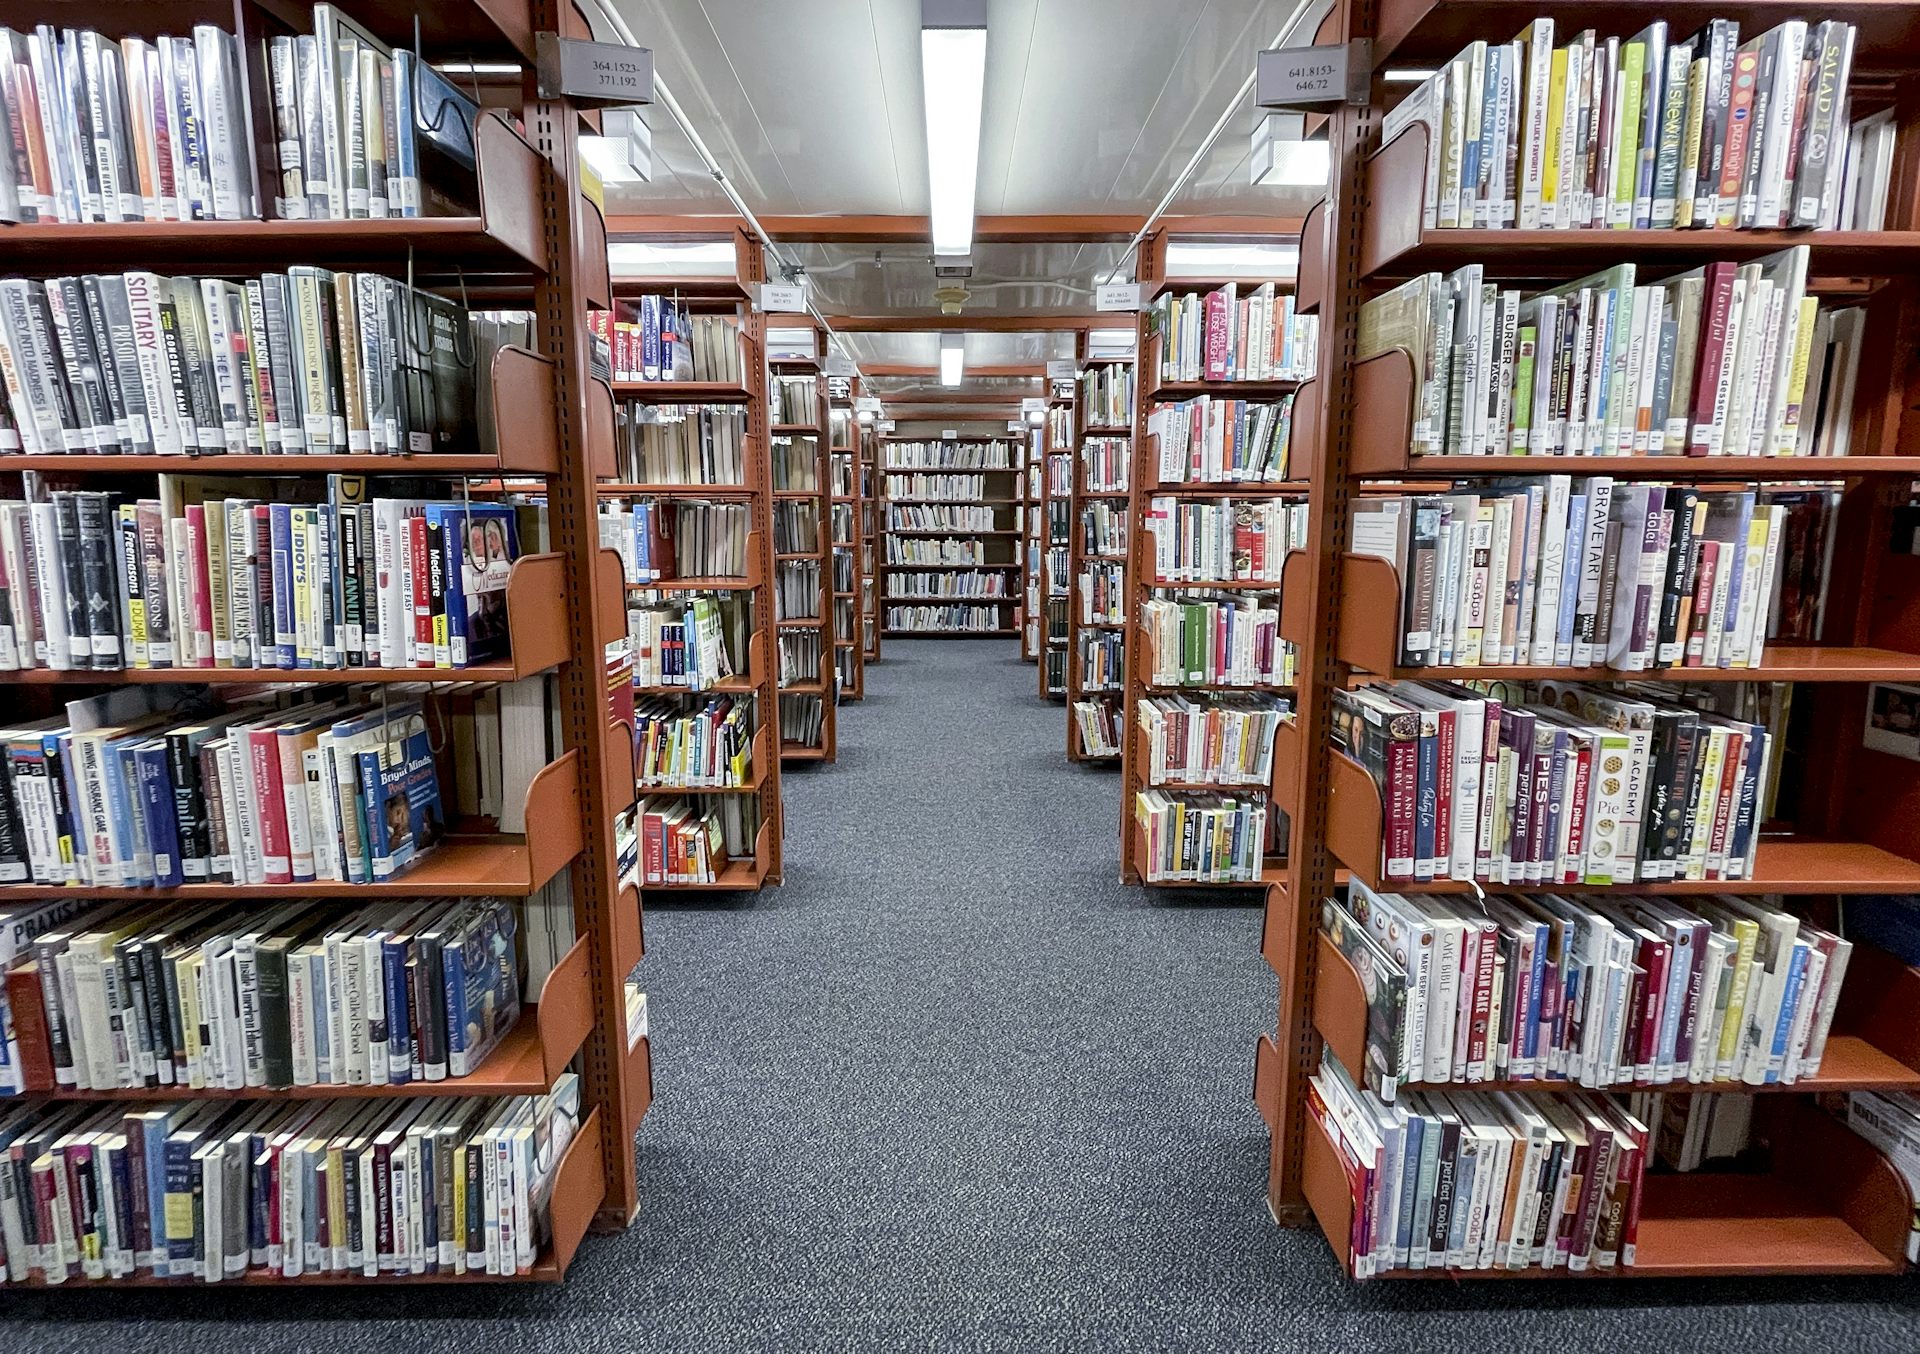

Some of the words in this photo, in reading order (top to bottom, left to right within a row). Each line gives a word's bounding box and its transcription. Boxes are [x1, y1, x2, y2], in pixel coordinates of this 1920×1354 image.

[593, 61, 640, 72] 364.1523-
[600, 75, 637, 86] 371.192
[1289, 66, 1336, 78] 641.8153-
[1819, 46, 1839, 112] SALAD
[1296, 80, 1328, 90] 646.72
[1500, 77, 1510, 105] ONE
[1483, 96, 1496, 129] Make
[1498, 108, 1507, 136] POT
[1758, 92, 1768, 129] PERFECT
[1483, 132, 1495, 141] It
[1730, 123, 1745, 151] pizza
[1755, 131, 1763, 149] PAN
[1726, 152, 1742, 177] night
[1750, 151, 1760, 175] PIZZA
[9, 288, 31, 331] JOURNEY
[20, 334, 36, 357] INTO
[128, 277, 157, 349] SOLITARY
[1711, 283, 1731, 342] Flavorful
[252, 330, 269, 368] JACKSON
[1435, 325, 1445, 368] MIGHTY
[1503, 314, 1514, 364] BURGER
[1722, 323, 1738, 376] american
[58, 328, 75, 358] STAND
[67, 361, 80, 383] TALL
[106, 370, 119, 401] PRISON
[1432, 372, 1441, 416] SALADS
[1626, 382, 1639, 408] Sweet
[1714, 380, 1730, 427] desserts
[143, 526, 156, 549] THE
[187, 525, 197, 539] 101
[361, 508, 374, 558] GUARANTEED
[1587, 487, 1609, 584] BRAVETART
[1644, 512, 1660, 543] dolci
[1679, 511, 1693, 554] momofuku
[231, 536, 247, 552] THE
[294, 532, 307, 583] IDIOT'S
[401, 526, 411, 570] HEALTHCARE
[124, 531, 140, 594] Freemasons
[212, 560, 221, 574] NEW
[363, 560, 375, 589] INCOME
[430, 549, 441, 596] Medicare
[1676, 555, 1685, 573] milk
[403, 572, 412, 591] MADE
[1542, 542, 1562, 613] SWEET
[1674, 574, 1685, 589] bar
[213, 578, 224, 613] FINANCIAL
[364, 592, 375, 608] FOR
[404, 594, 413, 611] EASY
[366, 610, 376, 624] LIFE
[1600, 603, 1611, 636] desserts
[83, 742, 98, 769] WINNING
[230, 741, 239, 755] THE
[1405, 748, 1414, 769] THE
[1634, 736, 1645, 755] PIE
[233, 758, 246, 798] DIVERSITY
[363, 767, 373, 787] Bright
[1394, 748, 1403, 785] PASTRY
[1537, 757, 1551, 803] PIES
[1405, 774, 1414, 790] PIE
[1517, 774, 1532, 815] perfect
[1625, 760, 1641, 816] ACADEMY
[1742, 776, 1755, 804] NEW
[90, 780, 105, 813] INSURANCE
[366, 788, 375, 807] Minds
[1393, 792, 1402, 818] BIBLE
[1405, 796, 1413, 819] AND
[1597, 800, 1621, 815] Pie
[1718, 796, 1729, 817] PIES
[95, 815, 108, 833] GAME
[175, 788, 196, 835] Emile
[239, 801, 251, 837] DELUSION
[1537, 804, 1546, 825] sweet
[1684, 807, 1697, 827] PIE
[1738, 807, 1750, 827] PIE
[1517, 818, 1527, 837] PIE
[1536, 826, 1544, 839] and
[1442, 933, 1454, 962] CAKE
[348, 963, 359, 988] Place
[1420, 953, 1429, 973] MARY
[1478, 939, 1495, 988] AMERICAN
[1418, 976, 1427, 998] BERRY
[1439, 964, 1451, 993] BIBLE
[1688, 971, 1703, 1014] perfect
[350, 990, 362, 1020] Called
[1475, 990, 1490, 1014] CAKE
[352, 1022, 363, 1054] School
[1685, 1016, 1694, 1038] CAKE
[449, 1033, 458, 1051] Wor
[1592, 1138, 1609, 1189] COOKIES
[1440, 1161, 1455, 1201] perfect
[1435, 1204, 1448, 1239] cookie
[1535, 1191, 1553, 1240] COOKIES
[1587, 1203, 1596, 1217] die
[1606, 1202, 1621, 1242] cookies
